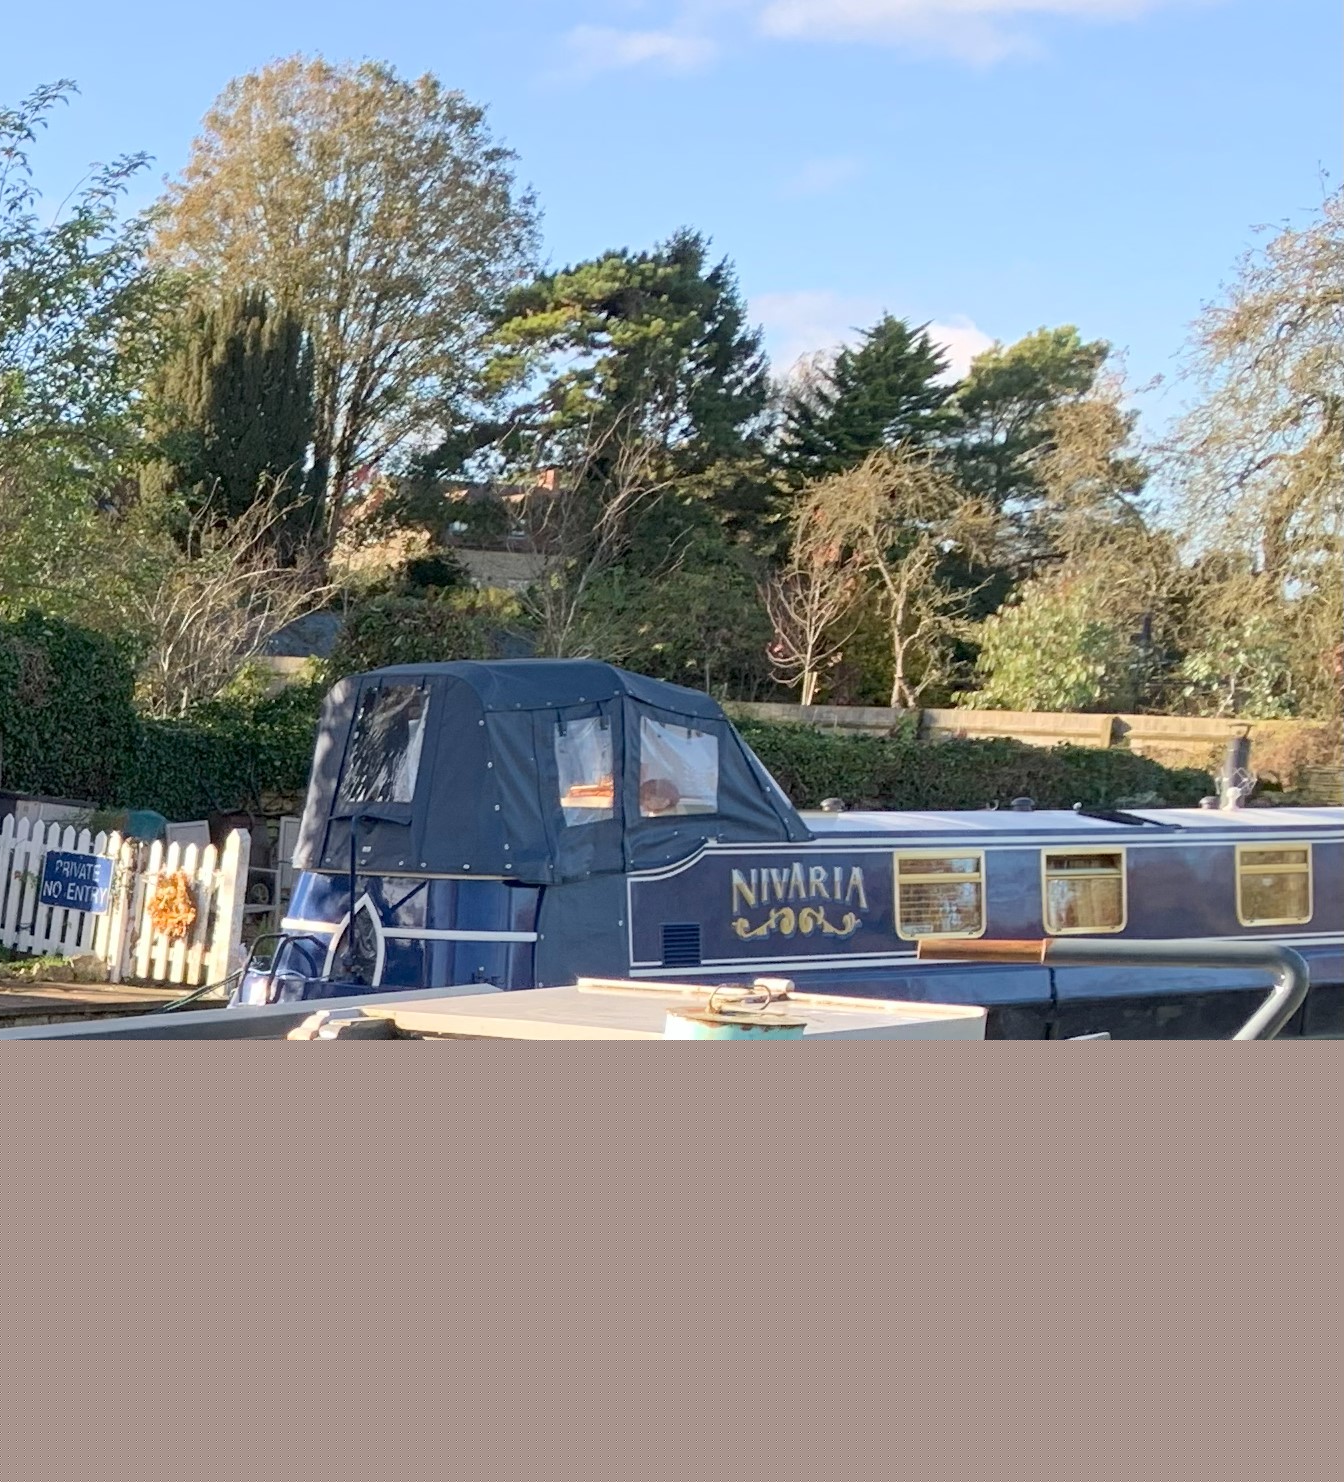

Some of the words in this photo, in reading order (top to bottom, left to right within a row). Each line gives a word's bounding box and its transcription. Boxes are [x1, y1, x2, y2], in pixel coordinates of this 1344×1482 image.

[55, 859, 102, 882] PRIVATE
[42, 880, 63, 899] NO
[66, 882, 108, 906] ENTRY
[731, 862, 869, 915] NIVARIA
